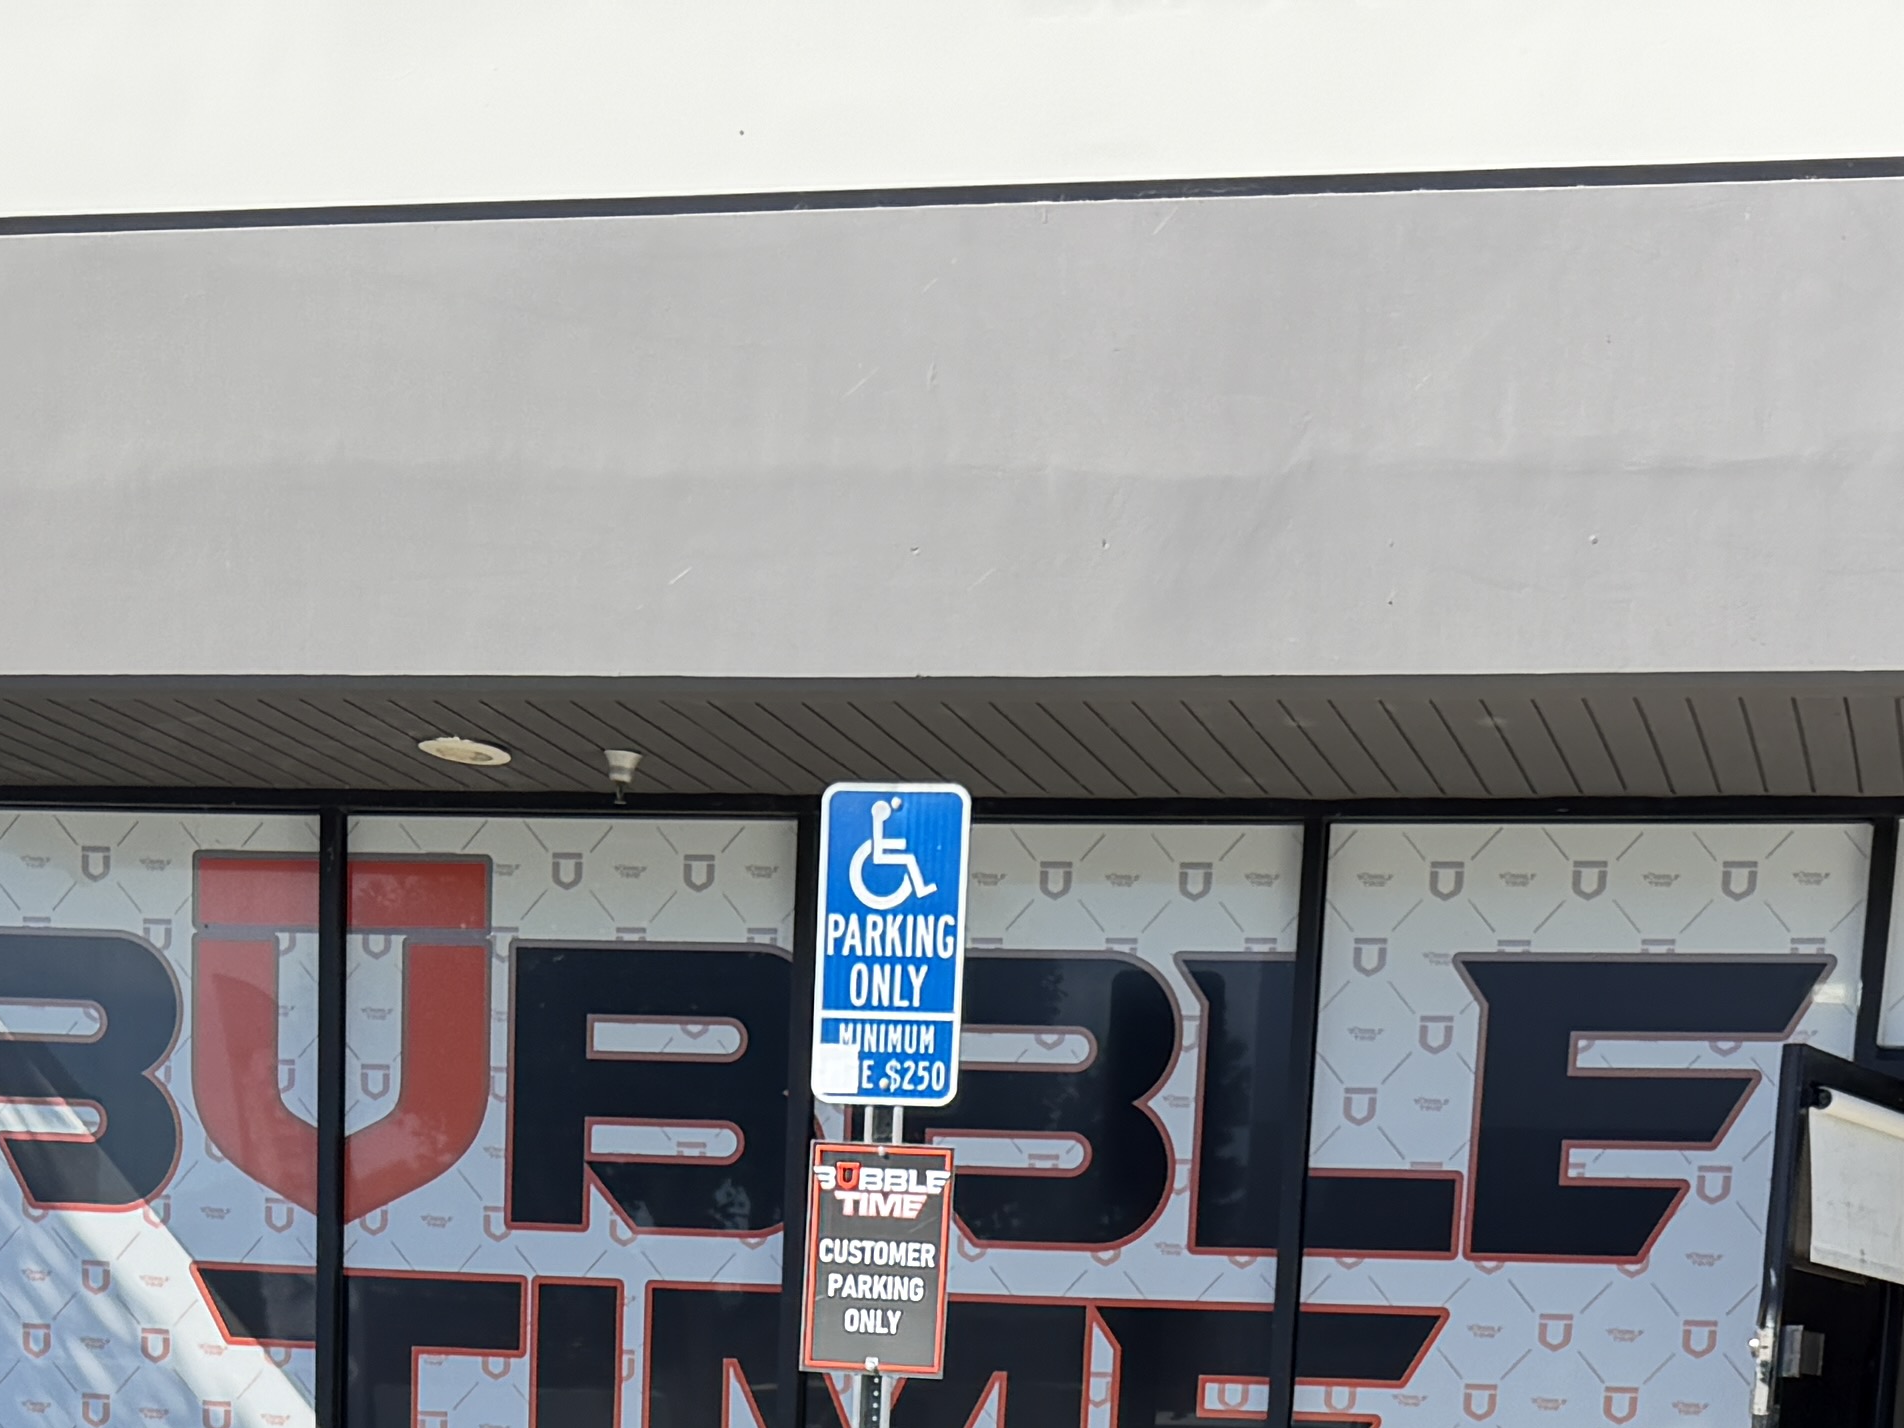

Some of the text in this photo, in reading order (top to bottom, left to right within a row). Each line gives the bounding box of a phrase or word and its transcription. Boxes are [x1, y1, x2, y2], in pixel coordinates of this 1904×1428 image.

[825, 913, 956, 959] PARKING
[849, 962, 929, 1008] ONLY
[838, 1022, 936, 1055] MINIMUM
[884, 1058, 946, 1093] $250
[813, 1161, 952, 1195] BUBBLE
[833, 1191, 928, 1219] TIME
[818, 1238, 936, 1268] CUSTOMER
[827, 1272, 925, 1302] PARKING
[844, 1307, 903, 1335] ONLY
